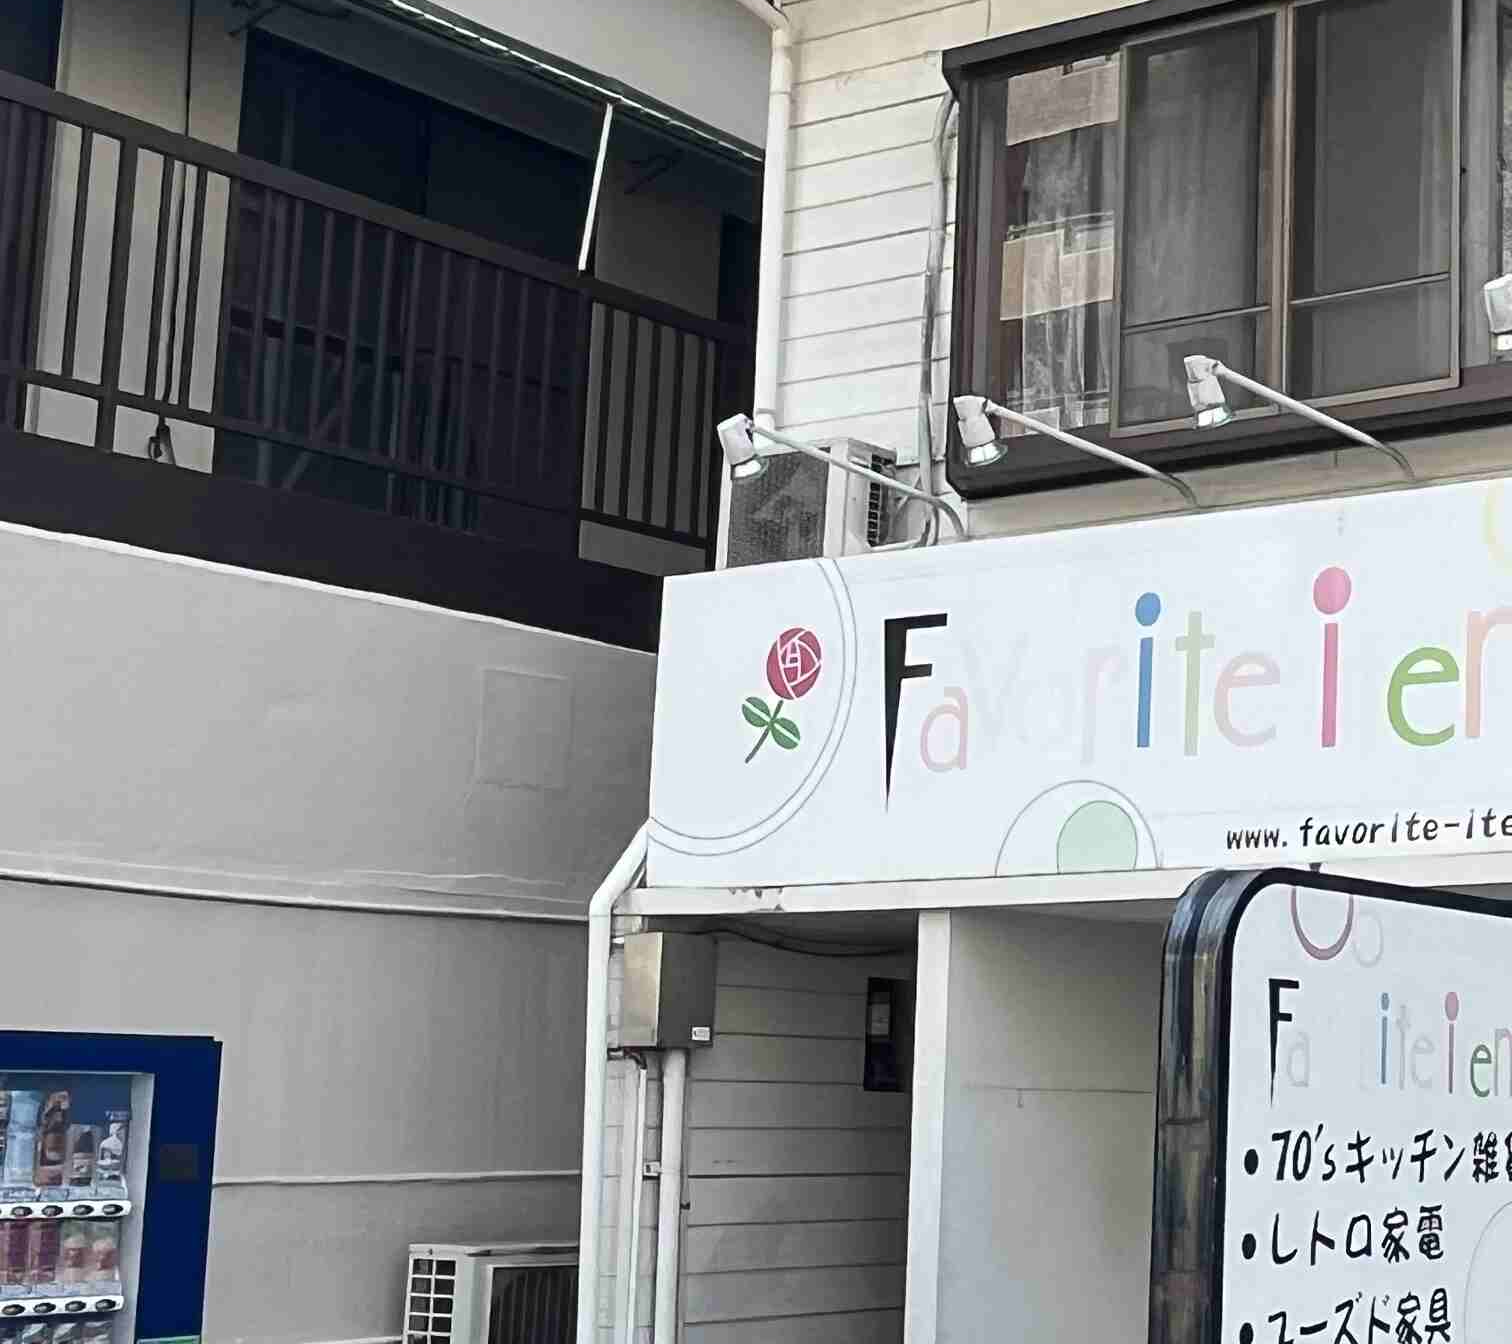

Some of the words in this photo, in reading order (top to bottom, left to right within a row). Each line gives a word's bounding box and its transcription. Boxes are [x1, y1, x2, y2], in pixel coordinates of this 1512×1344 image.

[1269, 1205, 1446, 1266] レトロ家電
